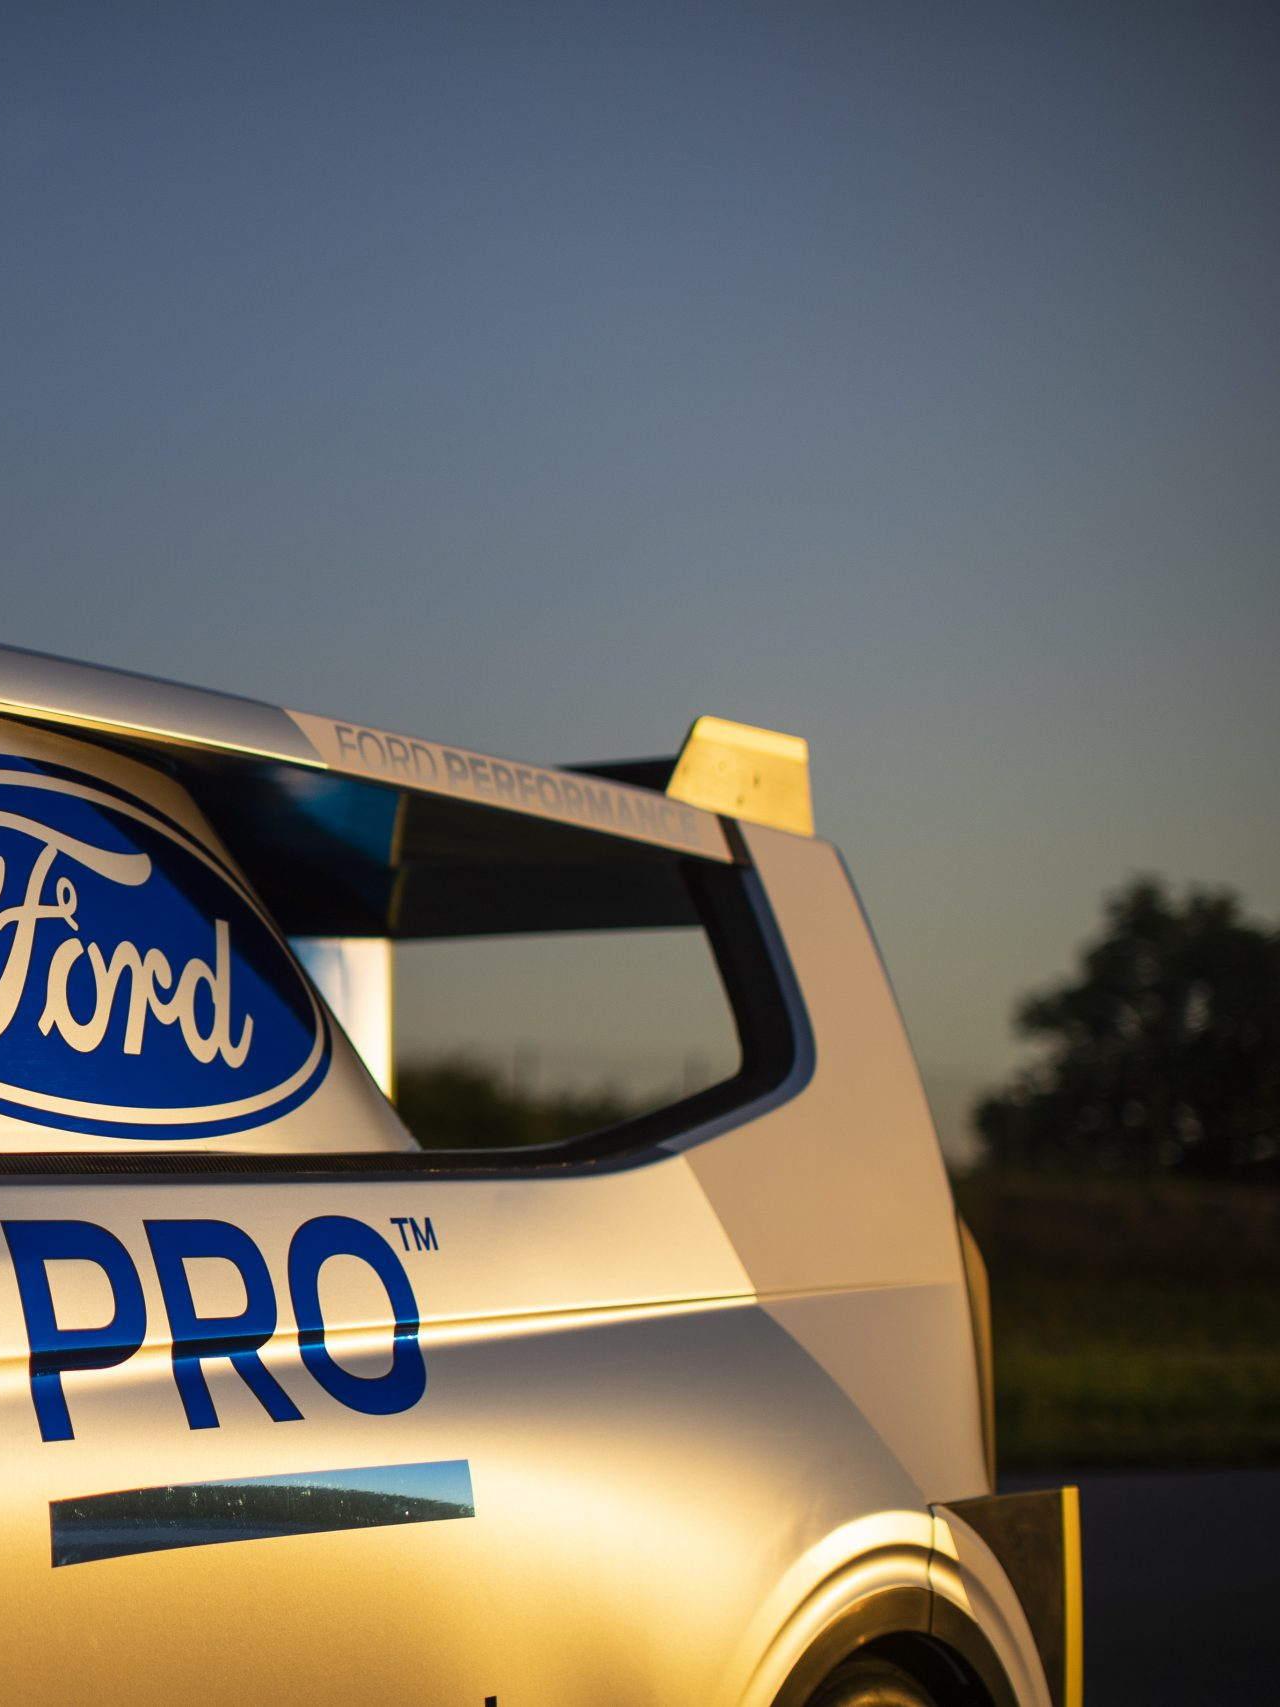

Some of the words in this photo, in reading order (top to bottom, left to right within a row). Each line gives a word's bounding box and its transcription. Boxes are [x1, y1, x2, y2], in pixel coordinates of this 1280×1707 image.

[333, 724, 438, 781] FORD
[443, 751, 703, 845] PERFORMANCE
[0, 1215, 427, 1442] PRO
